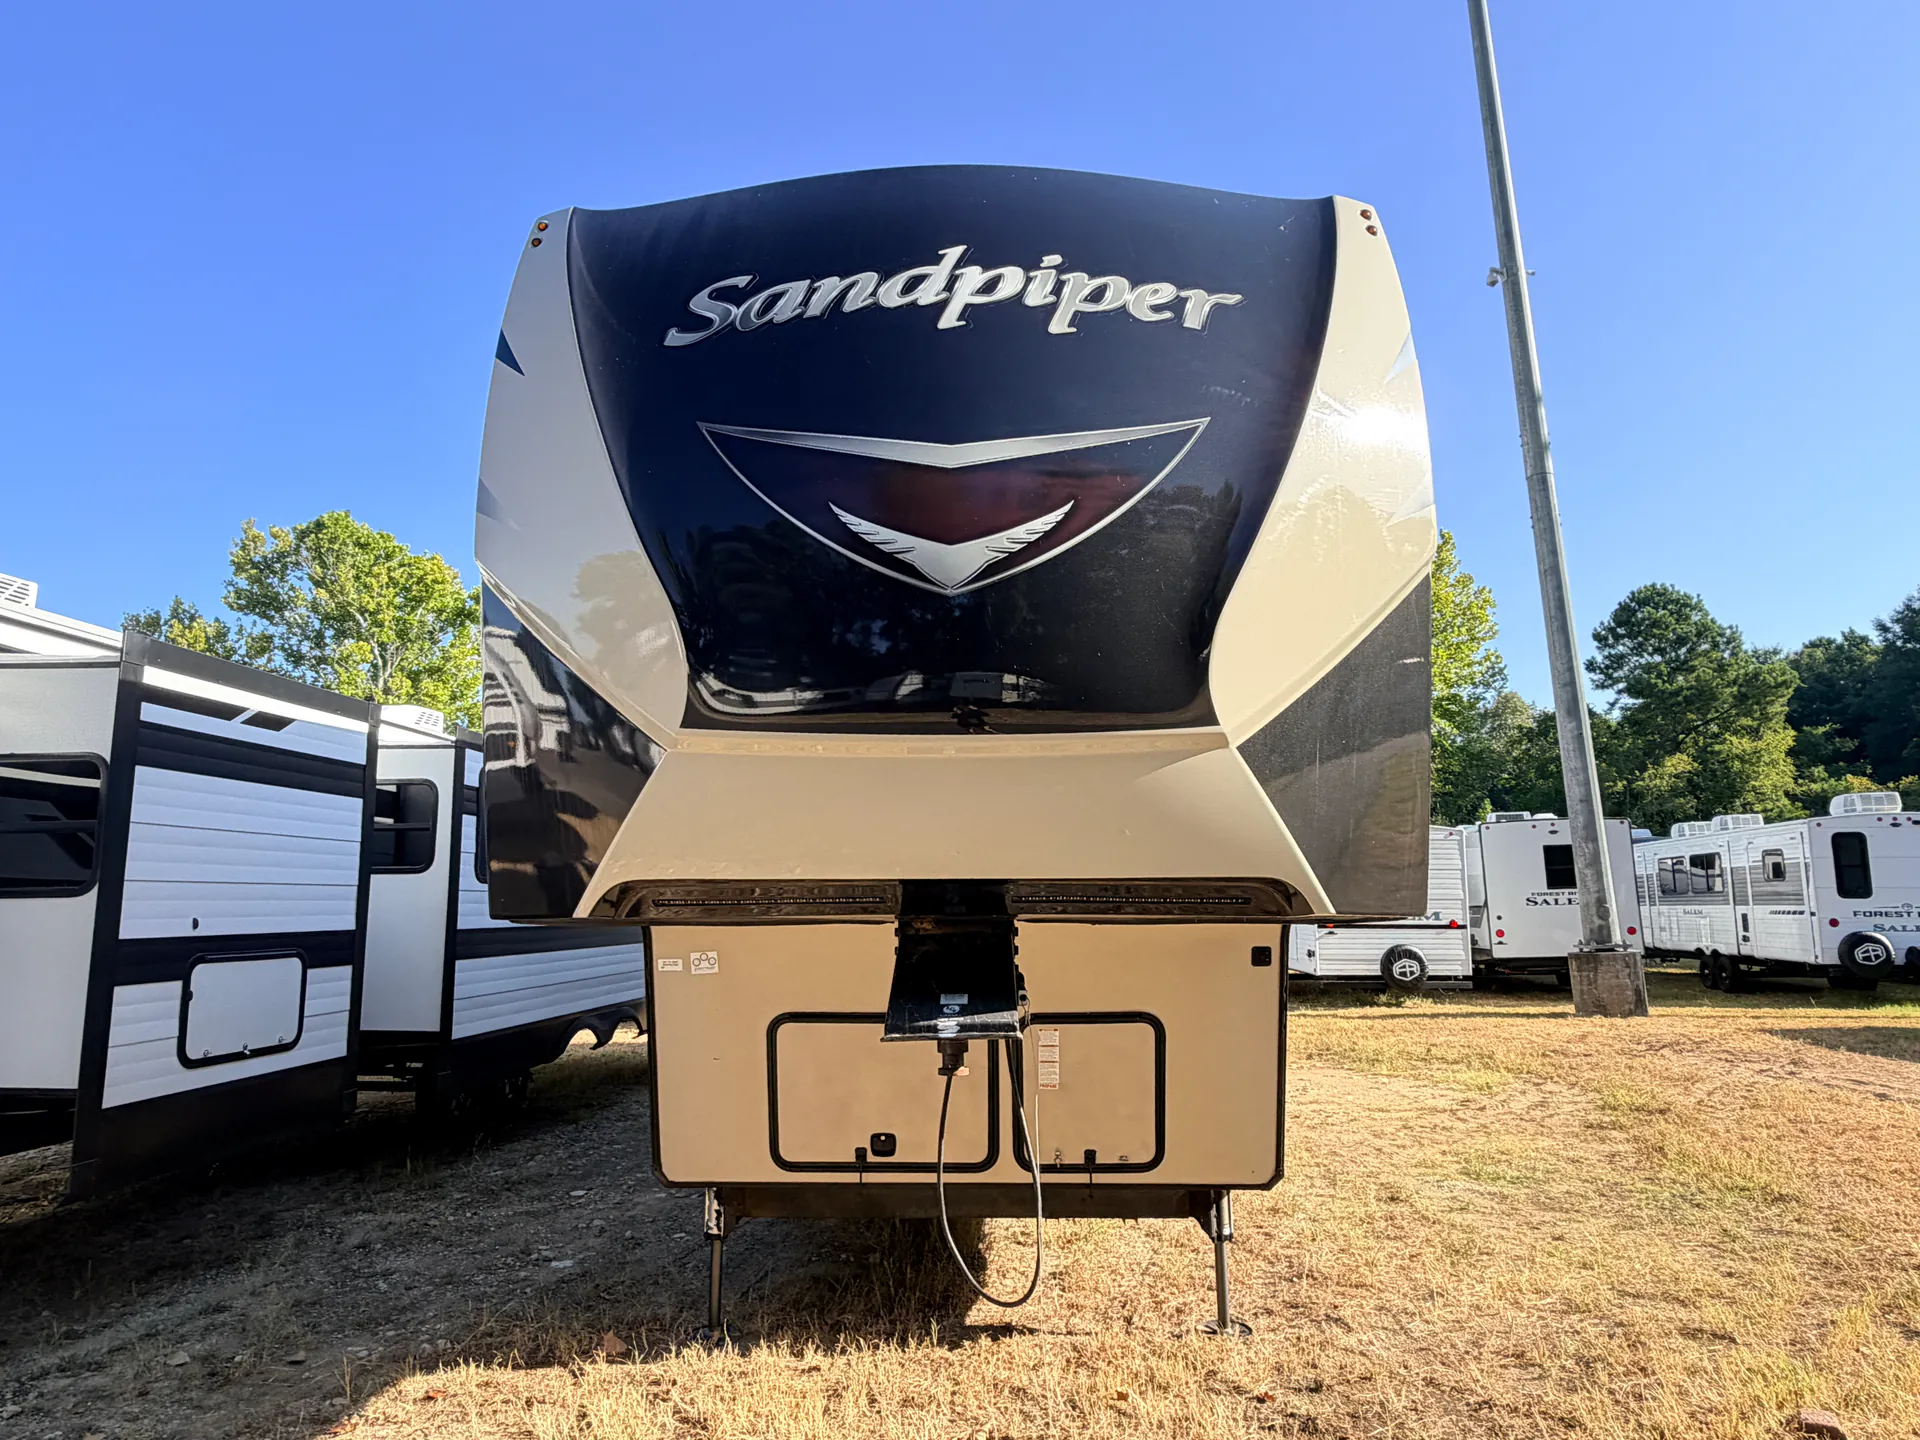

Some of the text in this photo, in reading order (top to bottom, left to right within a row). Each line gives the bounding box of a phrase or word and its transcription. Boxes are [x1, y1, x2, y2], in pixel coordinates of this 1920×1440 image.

[663, 244, 1243, 347] Sandpiper
[1525, 897, 1580, 907] SALE
[1853, 910, 1913, 918] FOREST
[1873, 923, 1920, 932] SALE
